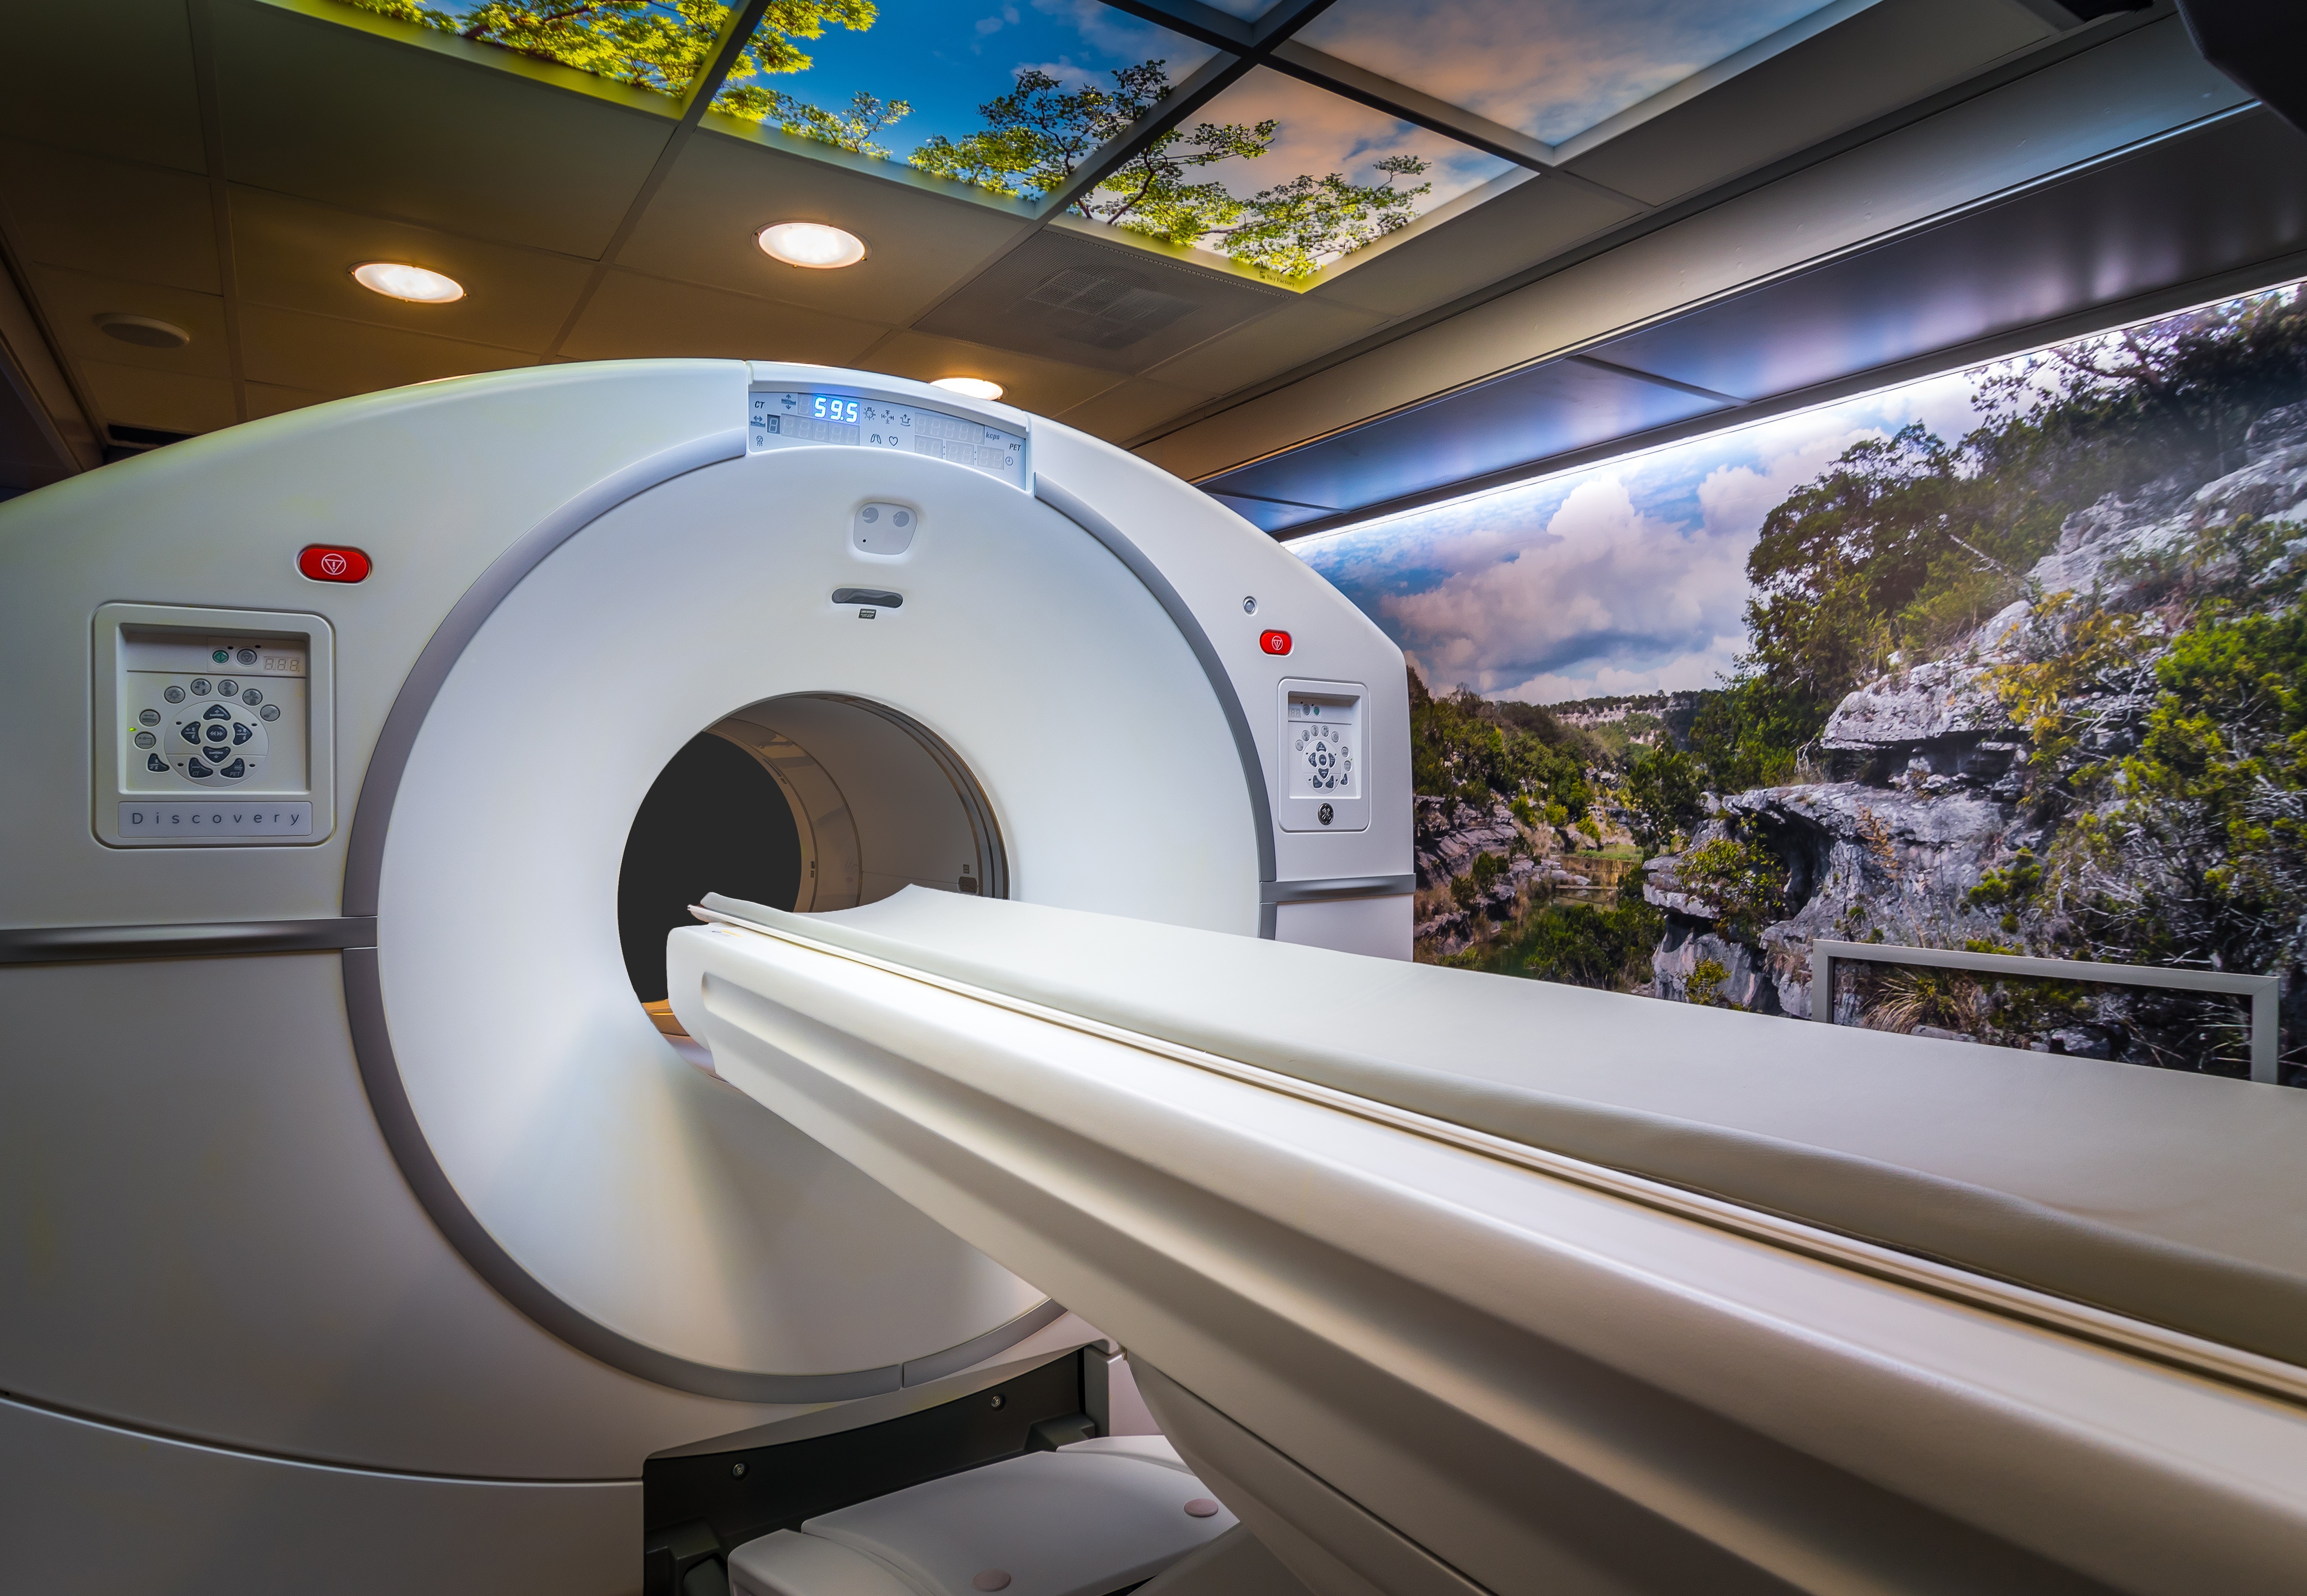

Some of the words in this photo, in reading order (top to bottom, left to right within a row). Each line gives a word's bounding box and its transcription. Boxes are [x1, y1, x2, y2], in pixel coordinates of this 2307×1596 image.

[755, 401, 765, 409] CT
[814, 396, 859, 423] 59.5
[986, 431, 1000, 440] kcps
[1009, 443, 1021, 451] PET
[132, 812, 300, 825] Discovery
